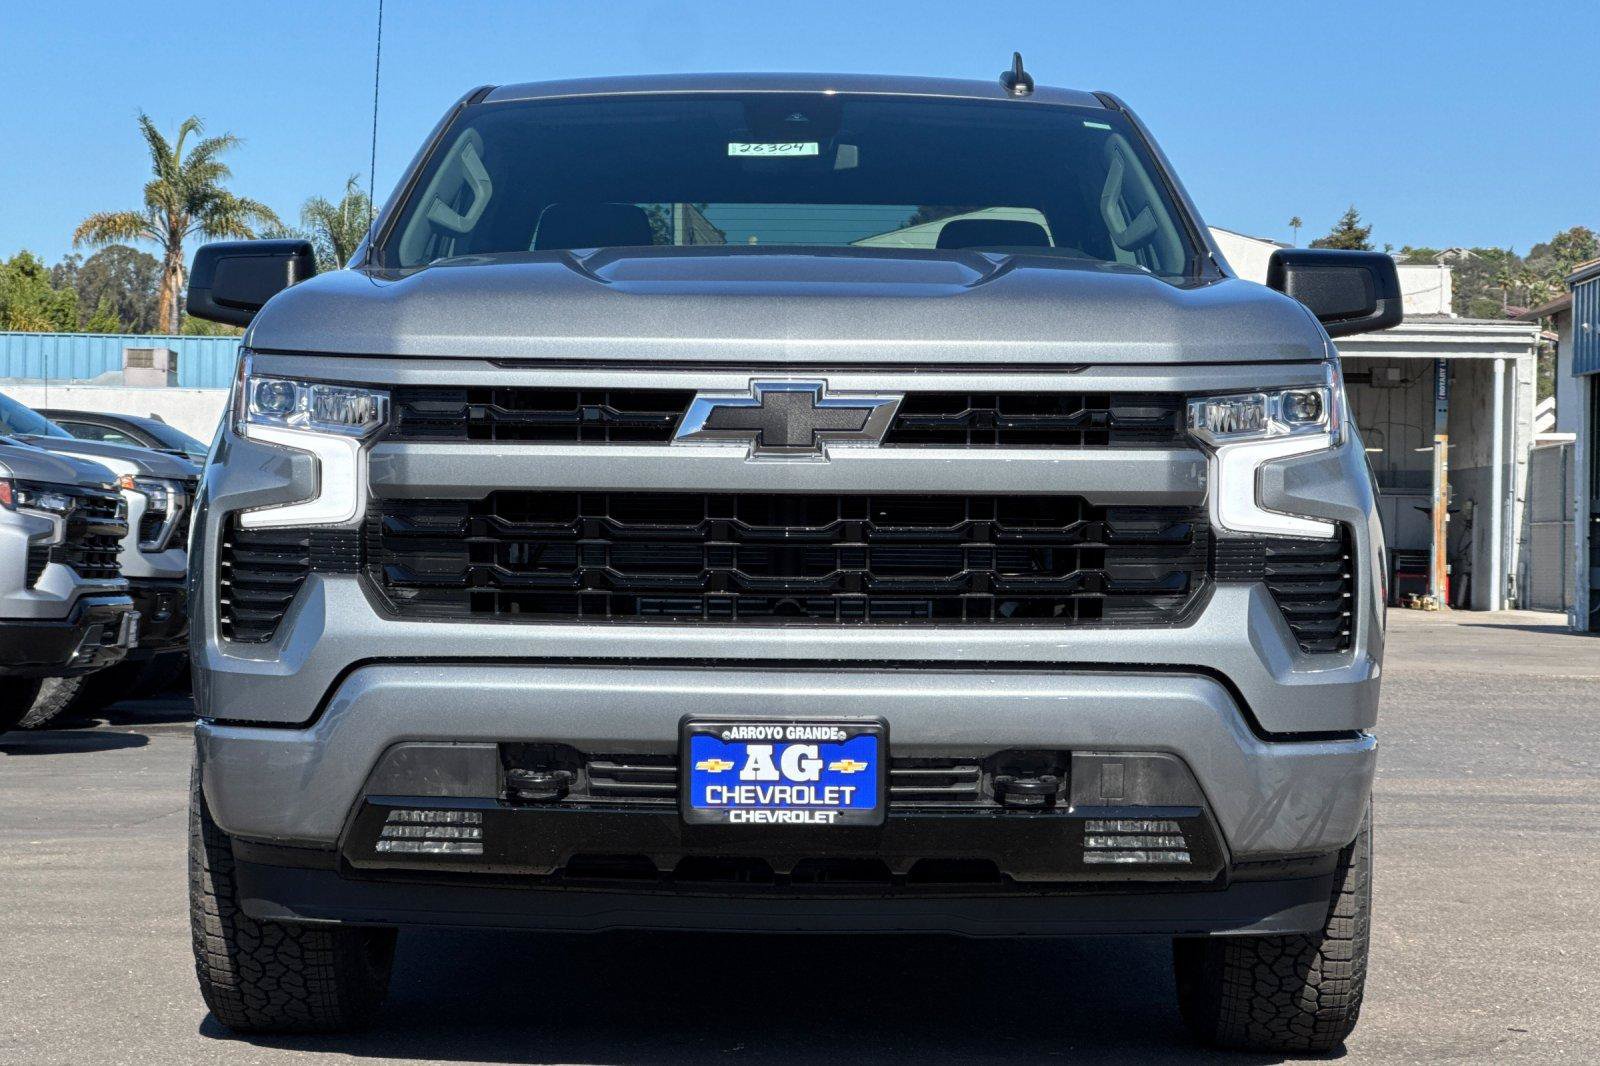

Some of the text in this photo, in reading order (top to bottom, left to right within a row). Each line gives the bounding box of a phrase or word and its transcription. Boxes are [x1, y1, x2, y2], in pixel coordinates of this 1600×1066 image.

[739, 143, 804, 153] 26304
[731, 726, 838, 740] ARROYO GRANDE
[739, 744, 823, 782] AG
[706, 785, 856, 805] CHEVROLET
[729, 810, 838, 824] CHEVROLET
